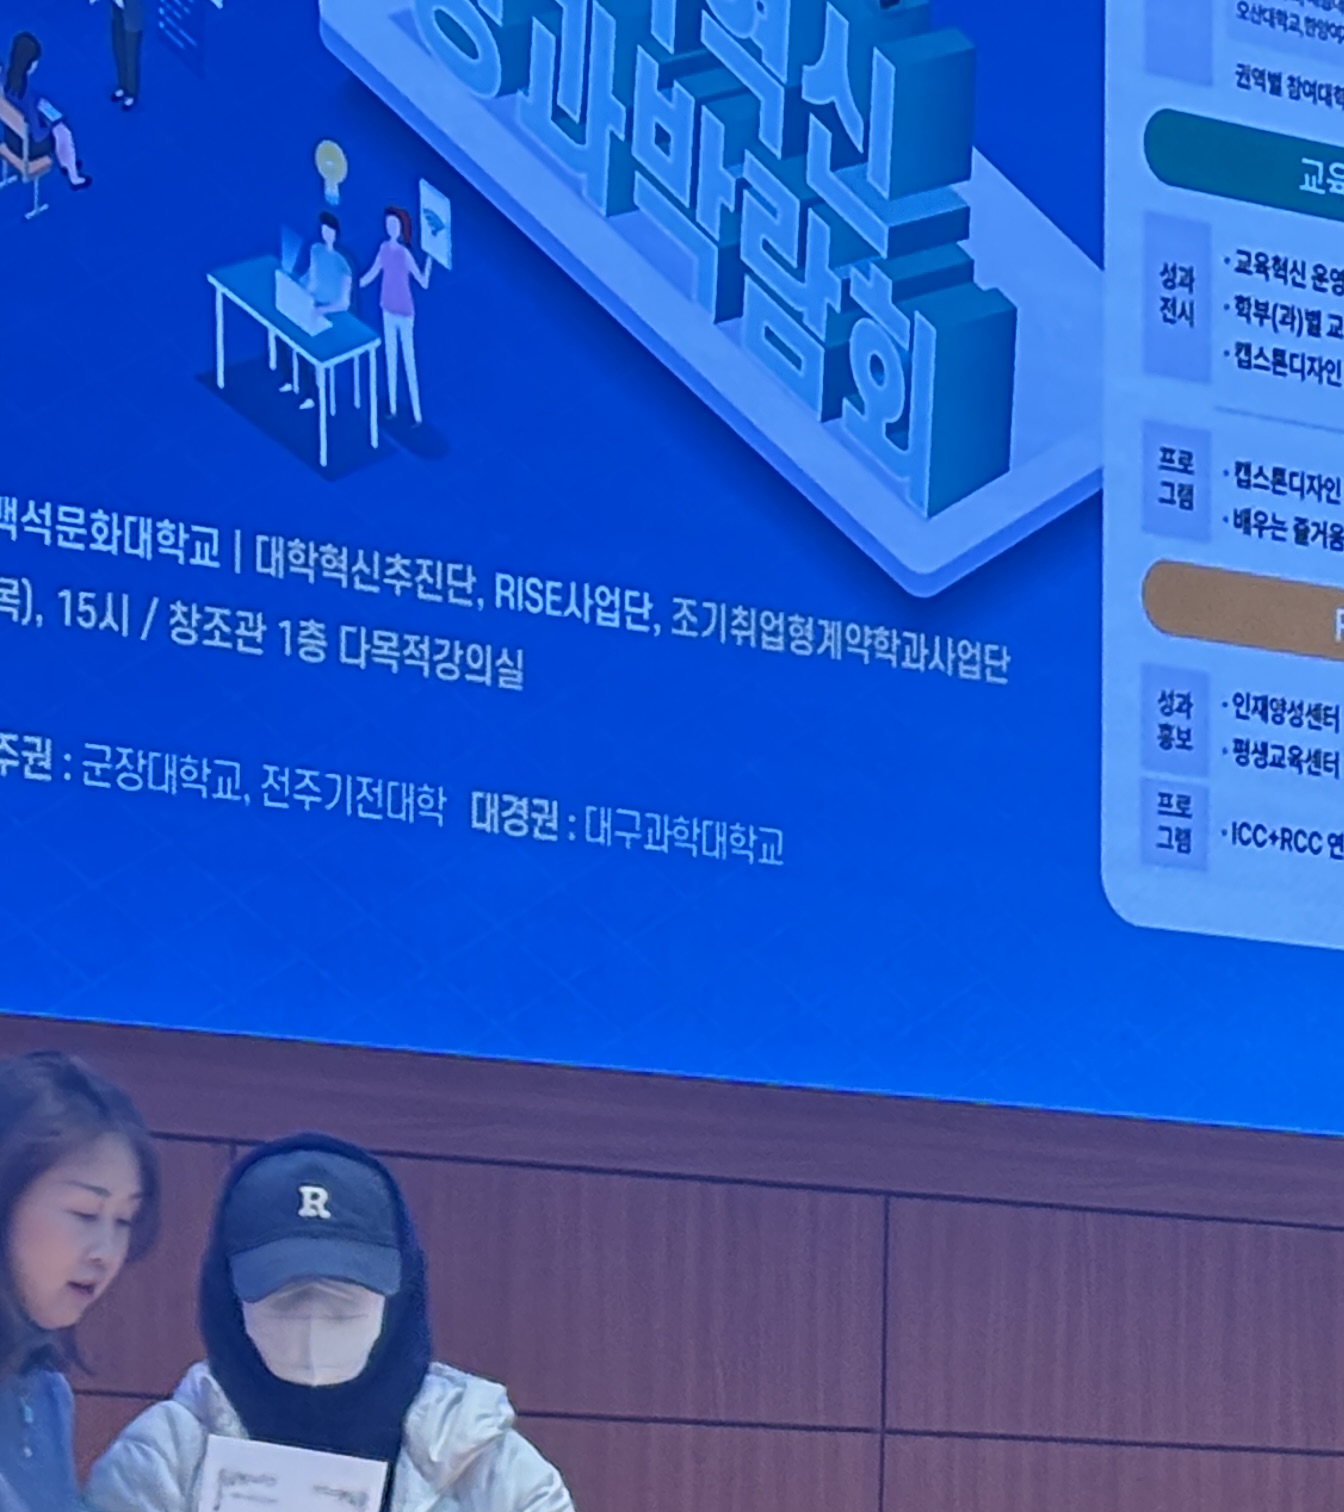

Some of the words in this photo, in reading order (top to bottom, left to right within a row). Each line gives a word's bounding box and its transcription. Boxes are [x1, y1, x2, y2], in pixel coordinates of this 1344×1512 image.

[1235, 63, 1282, 96] 권역별
[1160, 262, 1195, 294] 성과
[1234, 249, 1306, 289] 교육혁신
[1159, 297, 1194, 328] 전시
[1234, 295, 1322, 338] 학부(과)별
[1234, 342, 1342, 388] 캡스톤디자인
[1158, 446, 1195, 476] 프로
[1158, 481, 1194, 511] 그램
[1234, 461, 1341, 505] 캡스톤디자인
[1233, 508, 1287, 542] 배우는
[0, 495, 220, 569] 백석문화대학교
[255, 534, 484, 611] 대학혁신추진단,
[495, 572, 661, 637] RISE사업단,
[671, 596, 1012, 685] 조기취업형계약학과사업단
[57, 588, 129, 638] 15시
[169, 599, 266, 656] 창조관
[277, 617, 327, 664] 1층
[339, 625, 525, 691] 다목적강의실
[1157, 690, 1193, 720] 성과
[1157, 722, 1193, 751] 홍보
[1232, 738, 1340, 780] 평생교육센터
[82, 741, 250, 806] 군장대학교,
[260, 762, 447, 827] 전주기전대학
[470, 789, 559, 843] 대경권
[585, 805, 784, 866] 대구과학대학교
[1157, 792, 1192, 819] 프로
[1156, 825, 1192, 854] 그램
[1231, 821, 1322, 855] ICC+RCC
[298, 1185, 331, 1219] R
